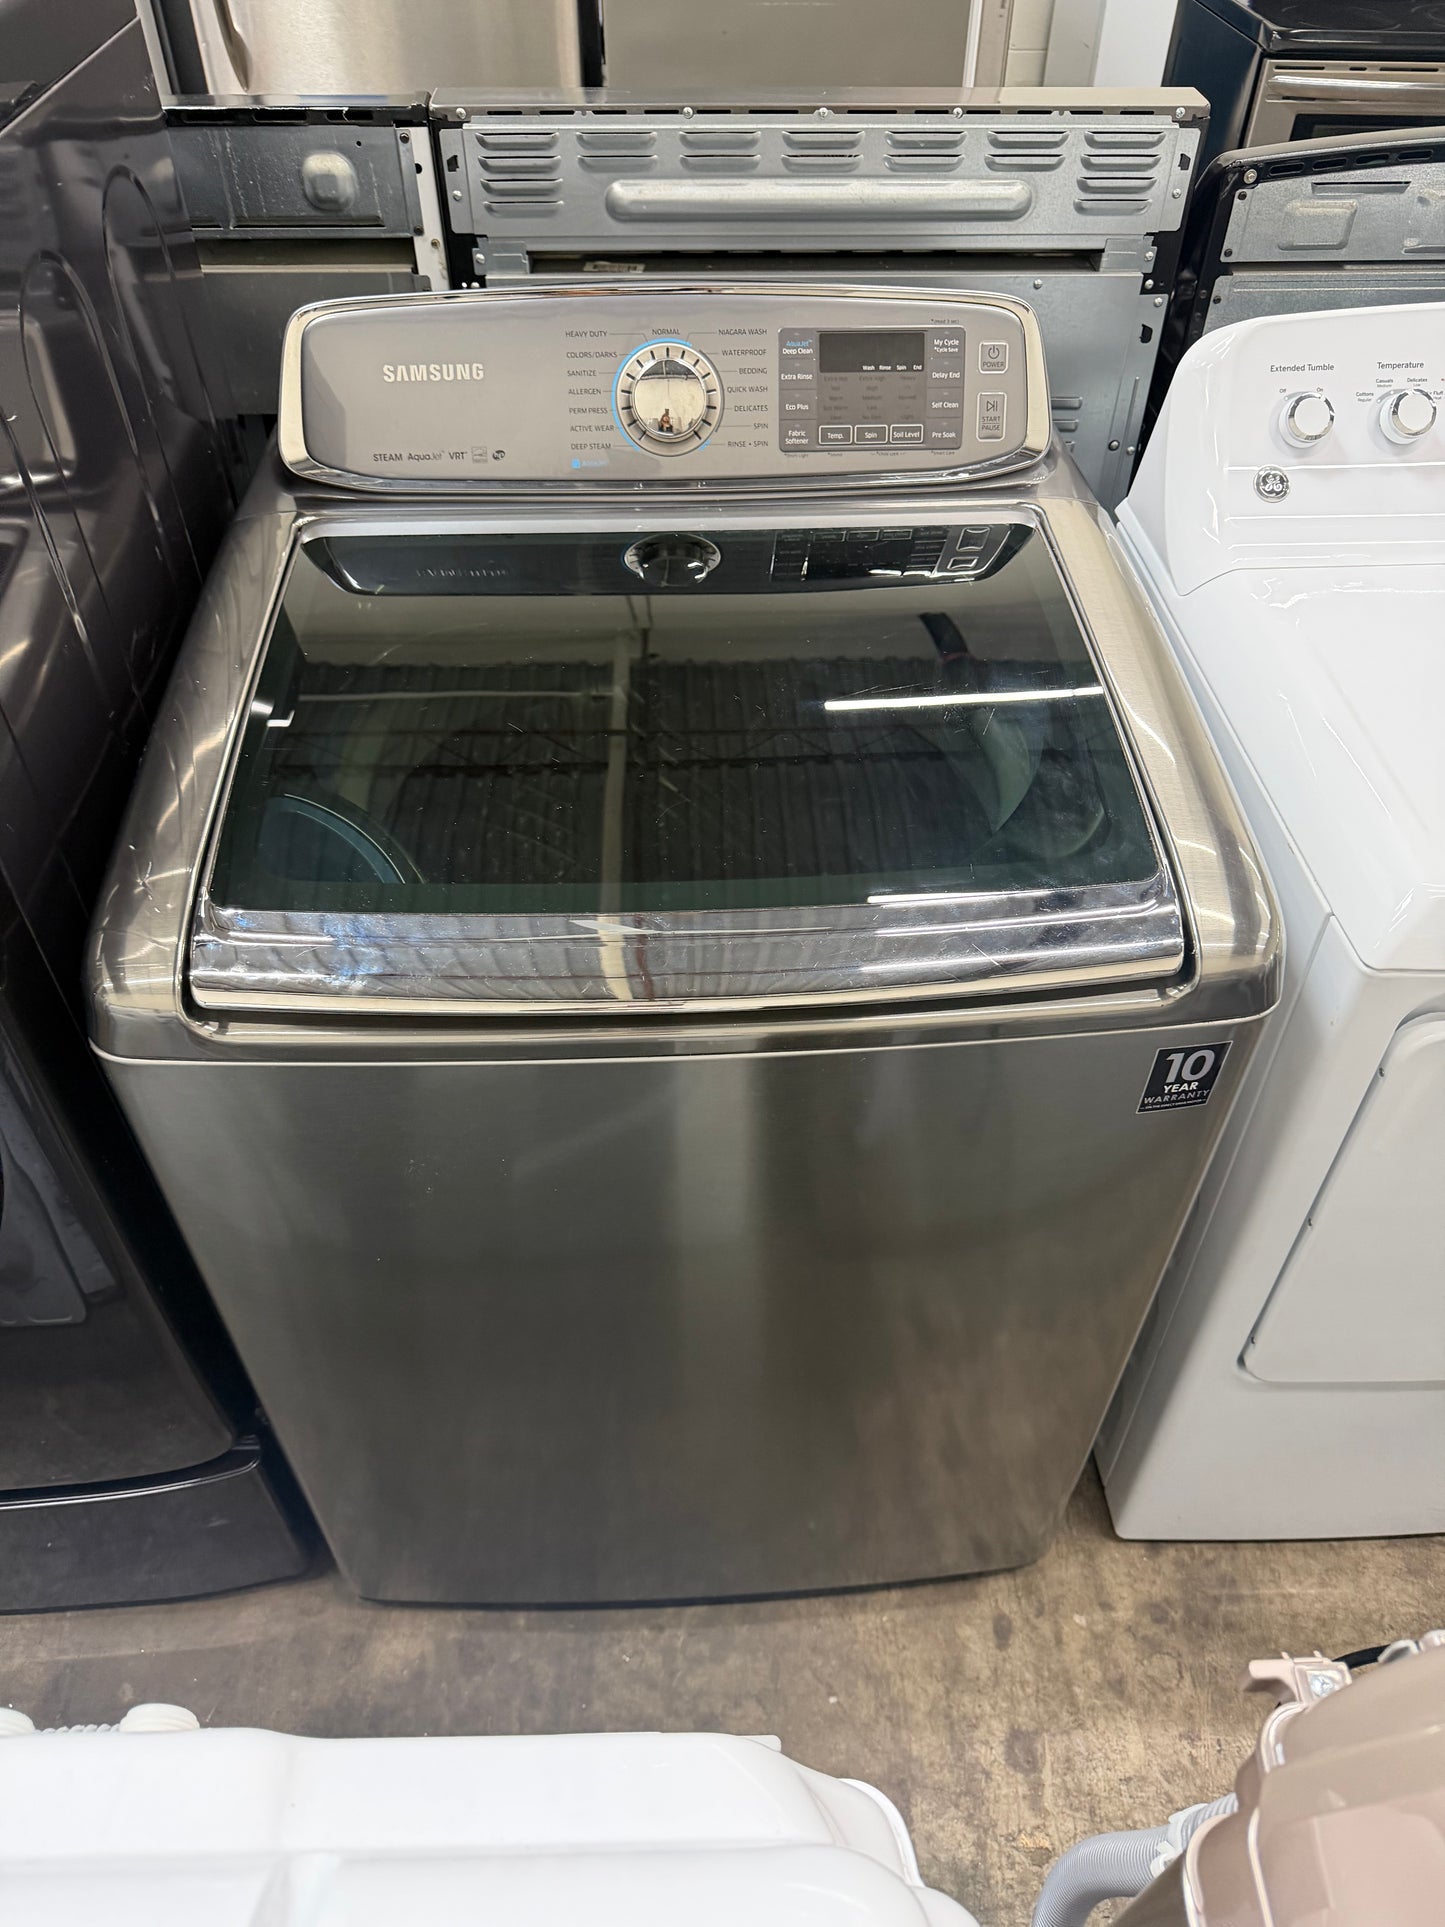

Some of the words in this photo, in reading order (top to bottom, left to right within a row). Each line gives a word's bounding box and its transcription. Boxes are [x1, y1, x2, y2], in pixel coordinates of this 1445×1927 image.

[589, 330, 608, 338] DUTY
[934, 338, 943, 346] My
[944, 338, 959, 346] Cycle
[566, 351, 618, 359] COLORS/DARKS
[982, 361, 1005, 369] POWER
[1270, 364, 1306, 372] Extended
[1308, 363, 1335, 372] Tumble
[1377, 361, 1424, 370] Temperature
[383, 363, 484, 383] SAMSUNG
[727, 386, 747, 394] QUICK
[595, 424, 614, 432] WEAR
[753, 422, 769, 430] SPIN
[981, 424, 1001, 432] PAUSE
[828, 432, 844, 440] Temp.
[864, 431, 878, 439] Spin
[373, 453, 403, 462] STEAM
[1165, 1049, 1215, 1083] 10
[1163, 1081, 1199, 1094] YEAR
[1144, 1089, 1211, 1104] WARRANTY
